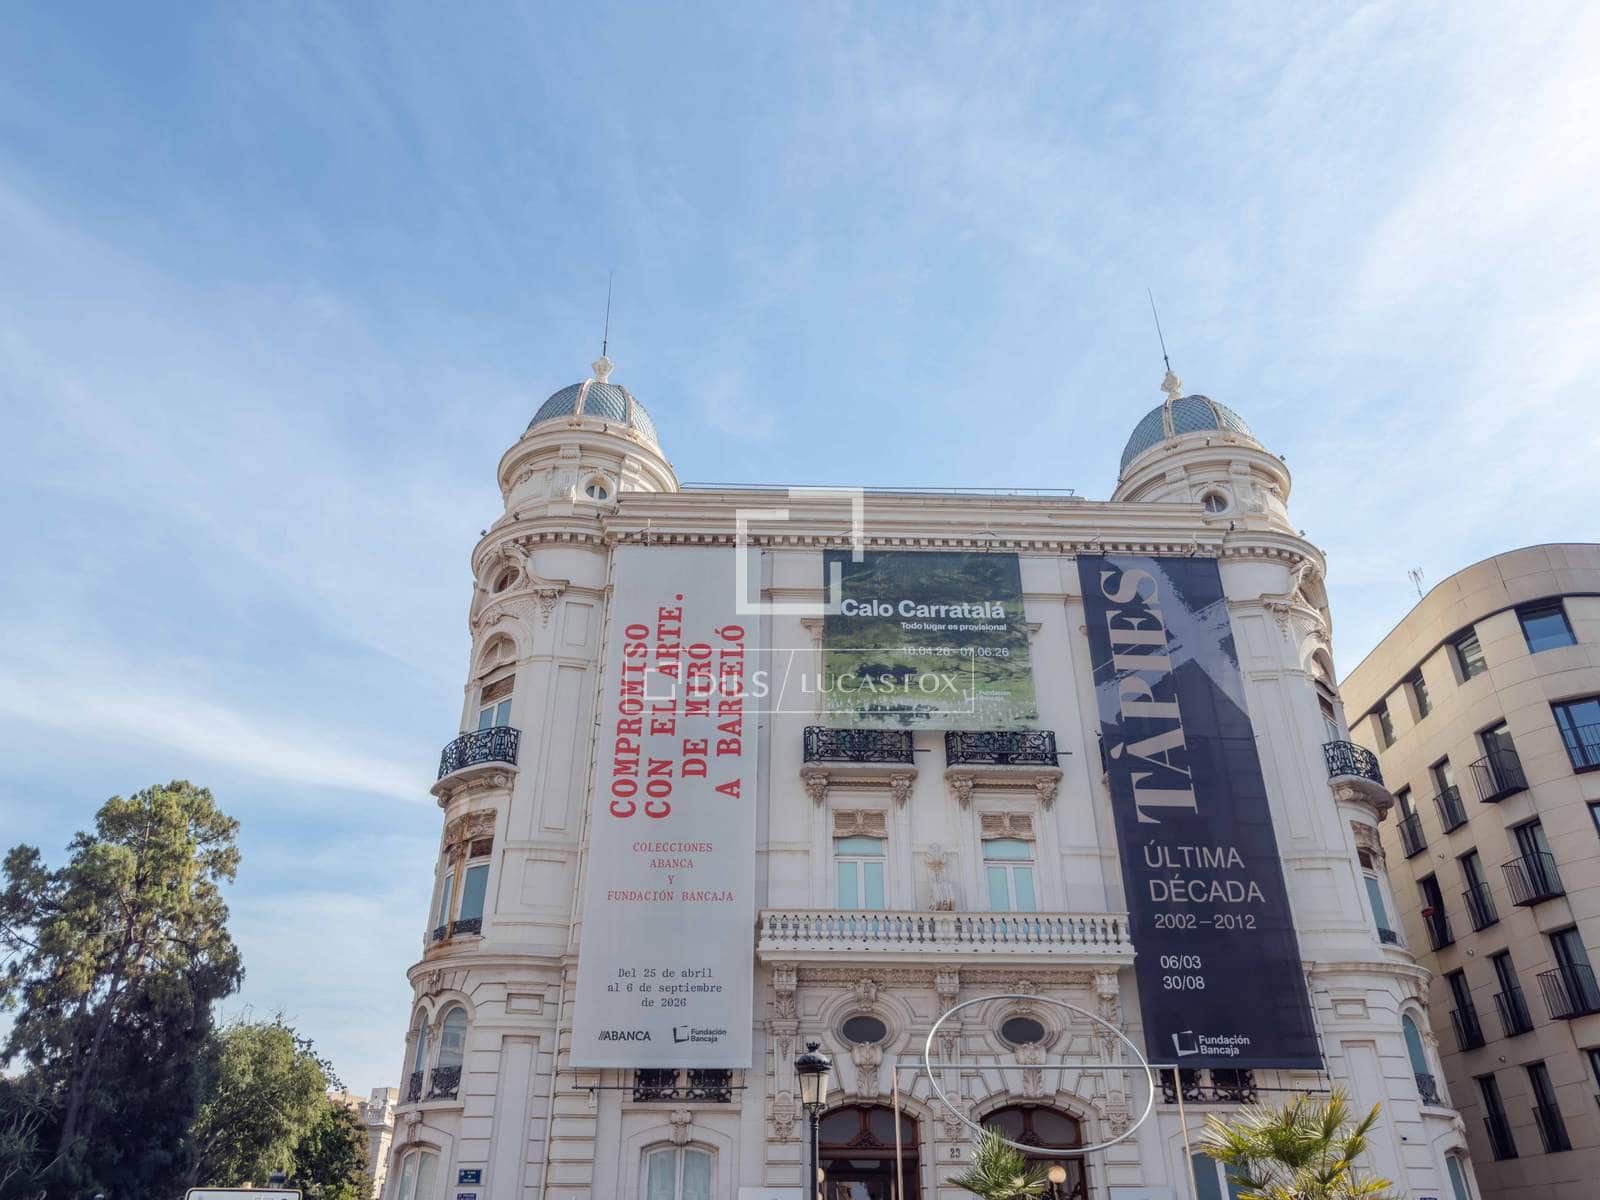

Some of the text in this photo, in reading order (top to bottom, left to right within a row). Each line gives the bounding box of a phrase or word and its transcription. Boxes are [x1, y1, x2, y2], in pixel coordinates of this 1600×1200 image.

[841, 598, 1005, 619] Calo Carratalá
[900, 622, 923, 630] Todo
[923, 622, 946, 631] lugar
[960, 623, 1007, 632] provisional
[960, 647, 1009, 657] 07.06.26
[1100, 569, 1198, 823] TÀPIES
[644, 594, 684, 819] CON EL ARTE.
[682, 643, 713, 778] DE MIRÓ
[714, 625, 745, 799] A BARCELÓ
[610, 624, 650, 818] COMPROMISO
[633, 842, 713, 852] COLECCIONES
[1143, 839, 1245, 868] ÚLTIMA
[650, 858, 694, 869] ABANCA
[668, 874, 675, 885] Y
[1149, 873, 1266, 903] DÉCADA
[607, 889, 734, 901] FUNDACIÓN BANCAJA
[1160, 955, 1202, 970] 06/03
[618, 968, 713, 978] Del 25 de abril
[608, 983, 722, 995] al 6 de septiembre
[1162, 976, 1205, 990] 30/08
[641, 998, 687, 1008] de 2026
[690, 1028, 727, 1036] Fundación
[691, 1035, 718, 1044] Bancaja
[1198, 1034, 1250, 1045] Fundación
[1199, 1045, 1240, 1057] Bancaja
